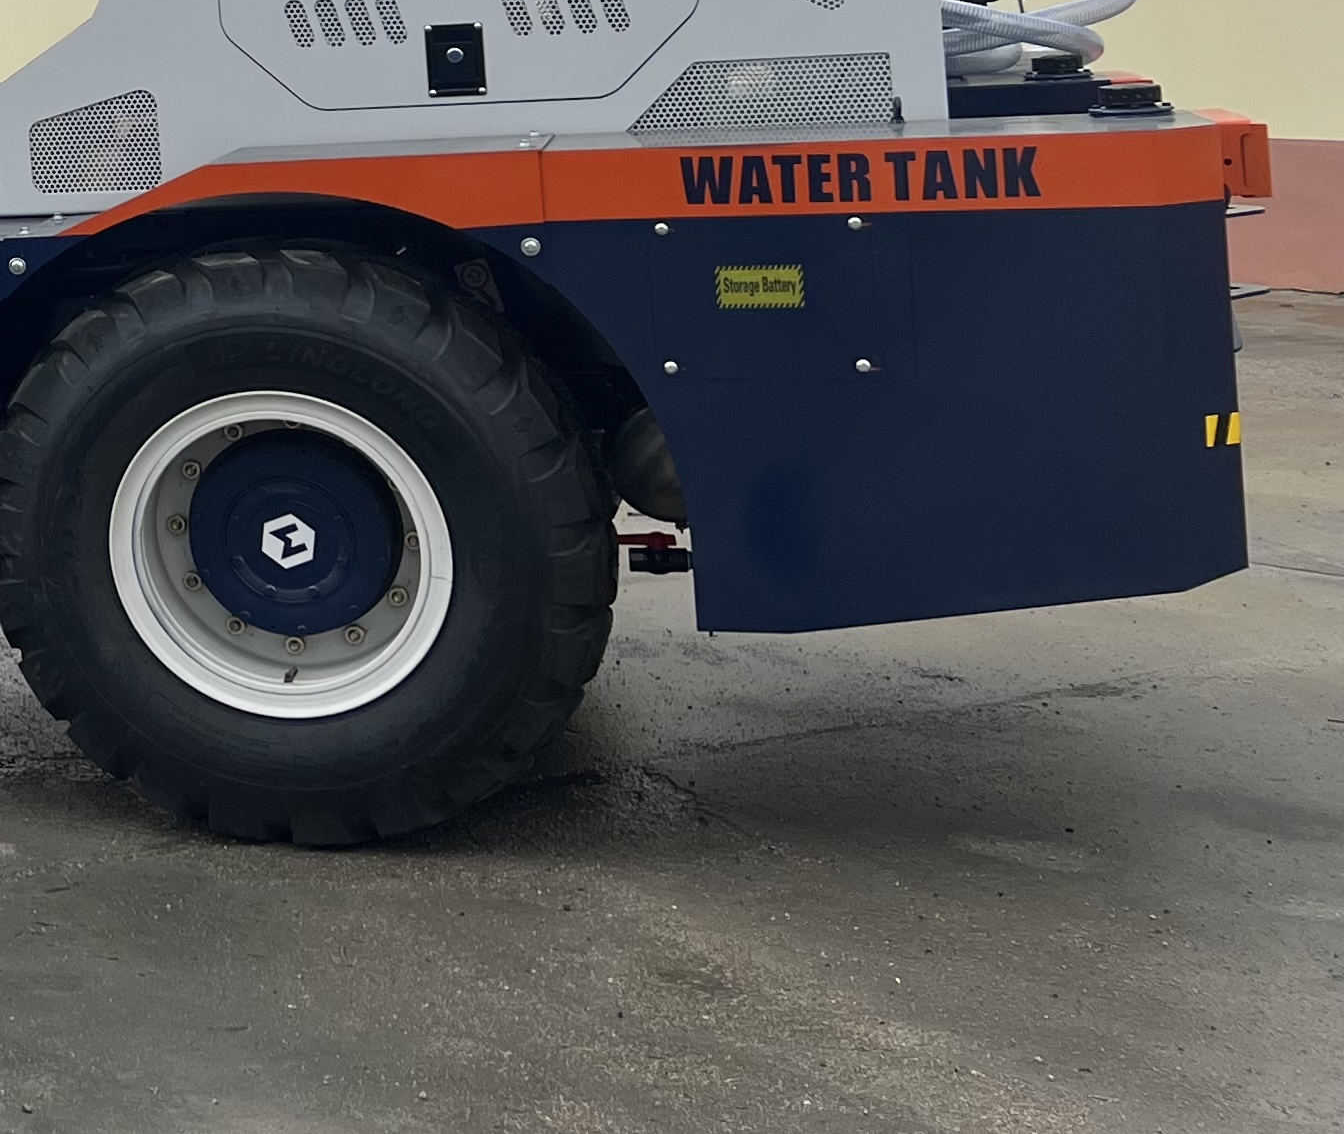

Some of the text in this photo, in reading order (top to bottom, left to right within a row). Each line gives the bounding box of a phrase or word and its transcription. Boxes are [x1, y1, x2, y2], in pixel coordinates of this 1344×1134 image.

[680, 146, 1042, 204] WATER TANK
[723, 276, 796, 297] Storage Battery
